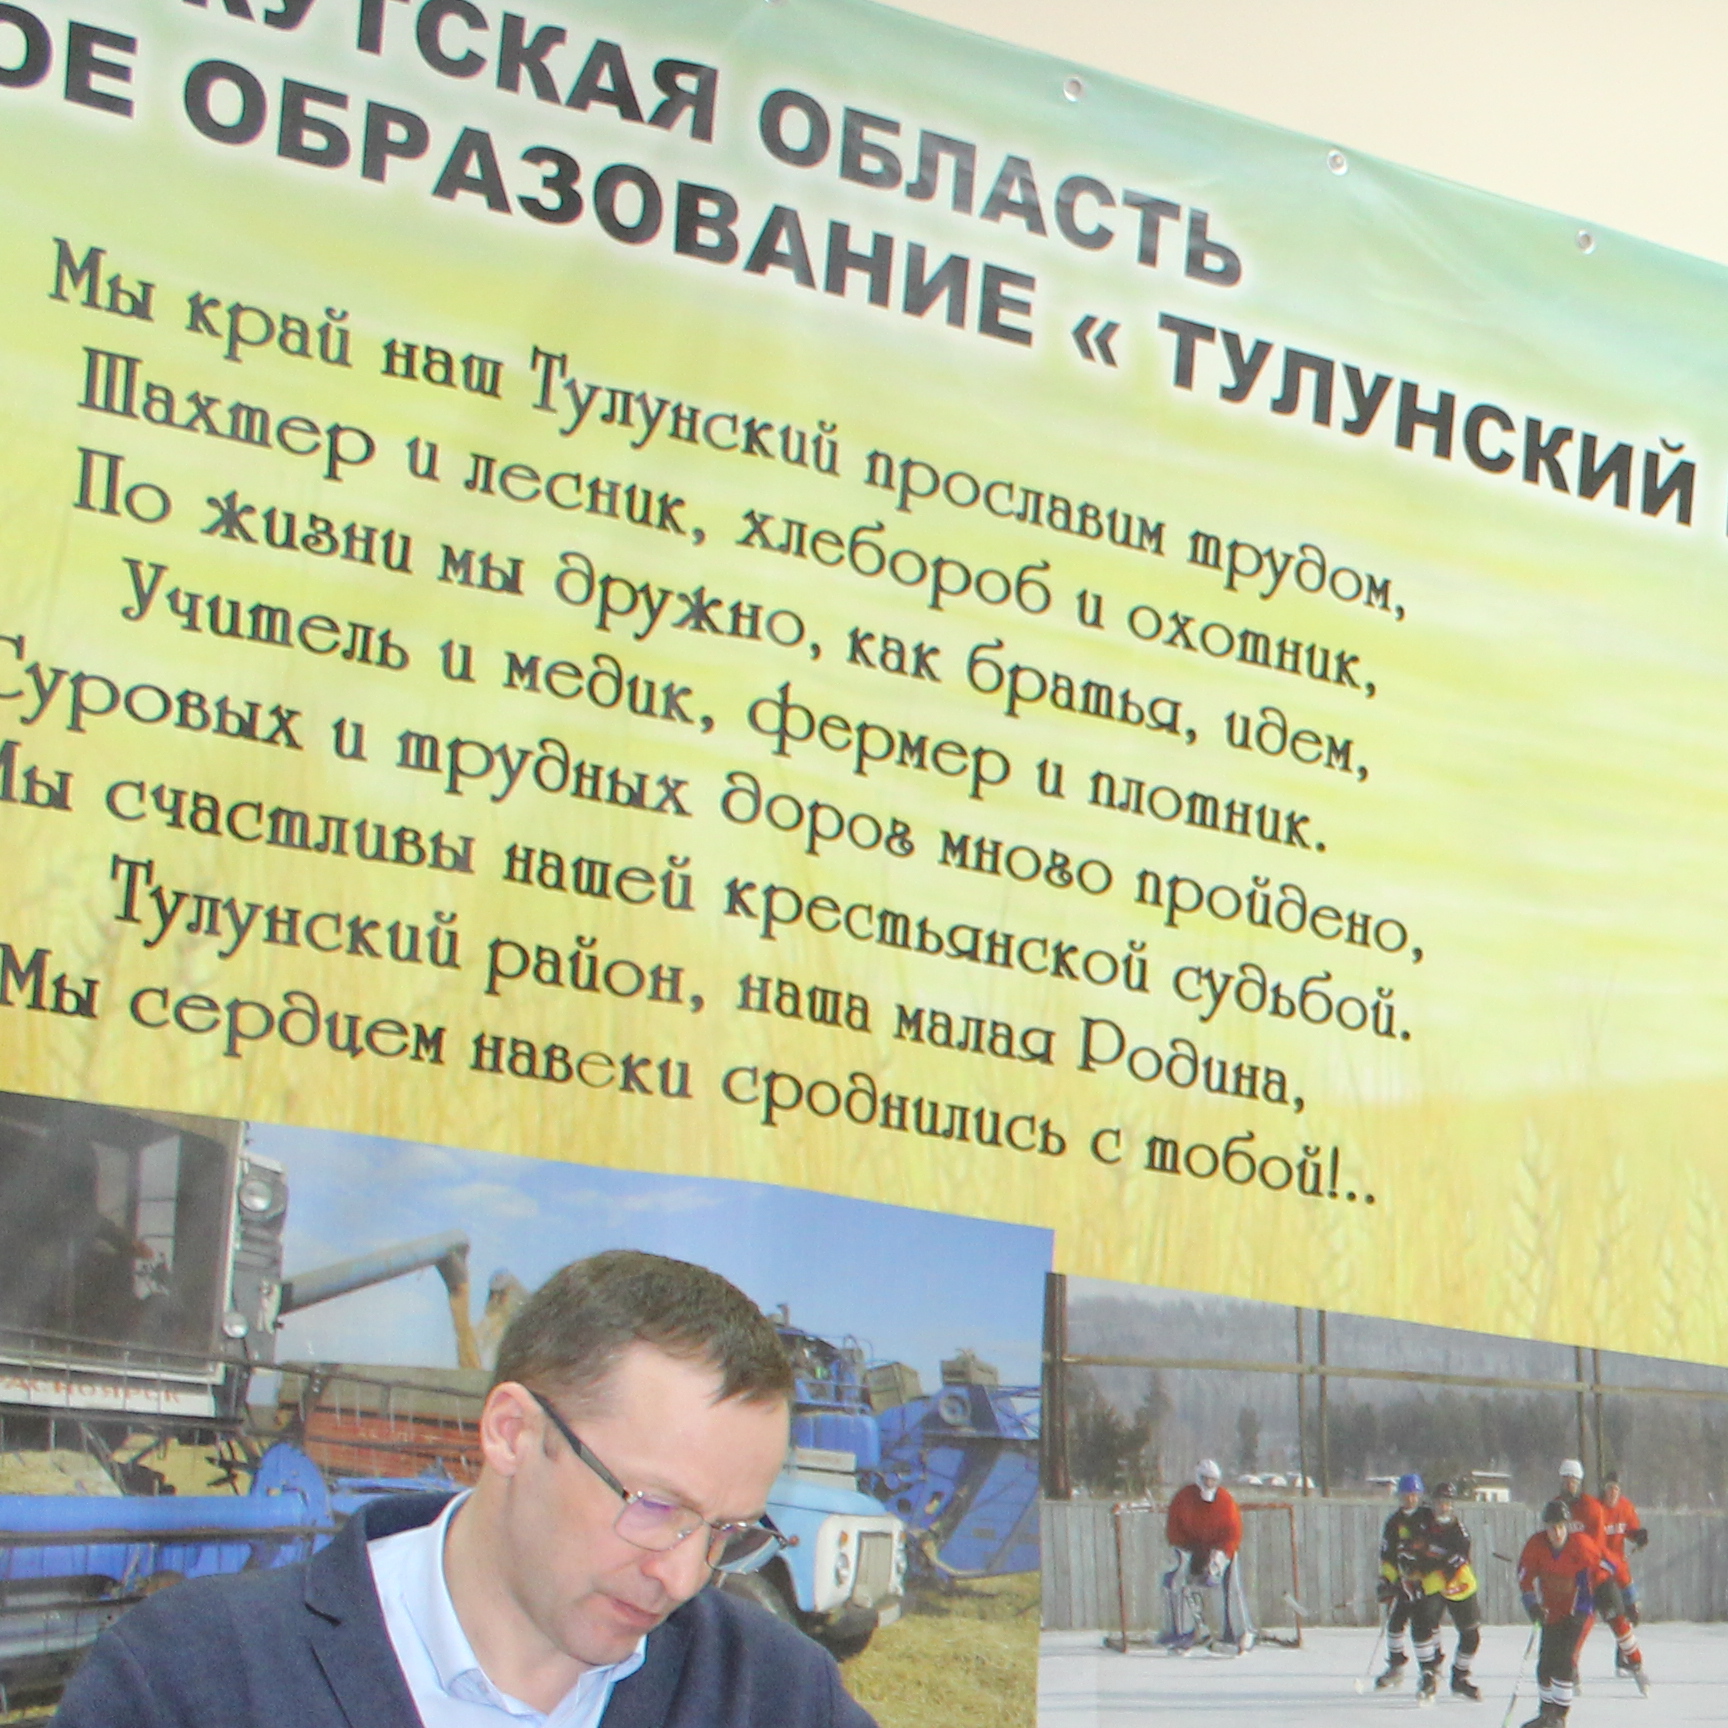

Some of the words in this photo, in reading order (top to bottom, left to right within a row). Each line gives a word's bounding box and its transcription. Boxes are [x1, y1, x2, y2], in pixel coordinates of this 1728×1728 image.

[183, 0, 719, 143] ТСКАЯ
[760, 89, 1241, 286] ОБЛАСТЬ
[49, 238, 155, 322] Мы
[186, 292, 352, 368] край
[381, 339, 504, 399] наш
[531, 345, 839, 477] Тулунский
[865, 450, 1165, 556] прославим
[1188, 530, 1405, 621] трудом,
[184, 60, 1036, 347] ОБРАЗОВАНИЕ
[1159, 313, 1696, 527] ТУЛУНСКИЙ
[74, 447, 171, 523] По
[201, 490, 412, 574] жизни
[438, 544, 524, 595] мы
[555, 552, 821, 660] дружно,
[847, 627, 941, 682] как
[967, 638, 1197, 745] братья,
[1225, 707, 1368, 782] идем,
[78, 347, 376, 482] Шахтер
[407, 437, 439, 482] и
[464, 453, 706, 545] лесник,
[736, 509, 1052, 614] хлебороб
[1077, 589, 1104, 629] и
[1128, 606, 1376, 698] охотник,
[122, 558, 409, 671] Учитель
[440, 639, 475, 683] и
[503, 652, 714, 733] медик,
[748, 681, 1011, 801] фермер
[1037, 758, 1064, 799] и
[1089, 770, 1326, 852] плотник.
[333, 717, 367, 761] и
[397, 730, 692, 817] трудных
[1135, 869, 1423, 964] пройдено,
[106, 781, 475, 874] счастливы
[503, 843, 695, 911] нашей
[724, 877, 1149, 993] крестьянской
[1173, 963, 1410, 1041] судьбой.
[111, 854, 461, 969] Тулунский
[485, 935, 704, 1013] район,
[737, 973, 871, 1033] наша
[893, 1004, 1056, 1065] малая
[1078, 1017, 1304, 1114] Родина,
[0, 943, 100, 1020] Мы
[130, 987, 447, 1065] сердцем
[470, 1031, 693, 1099] навеки
[722, 1067, 1067, 1157] сроднились
[1091, 1129, 1121, 1165] с
[1145, 1131, 1375, 1205] тобой!..
